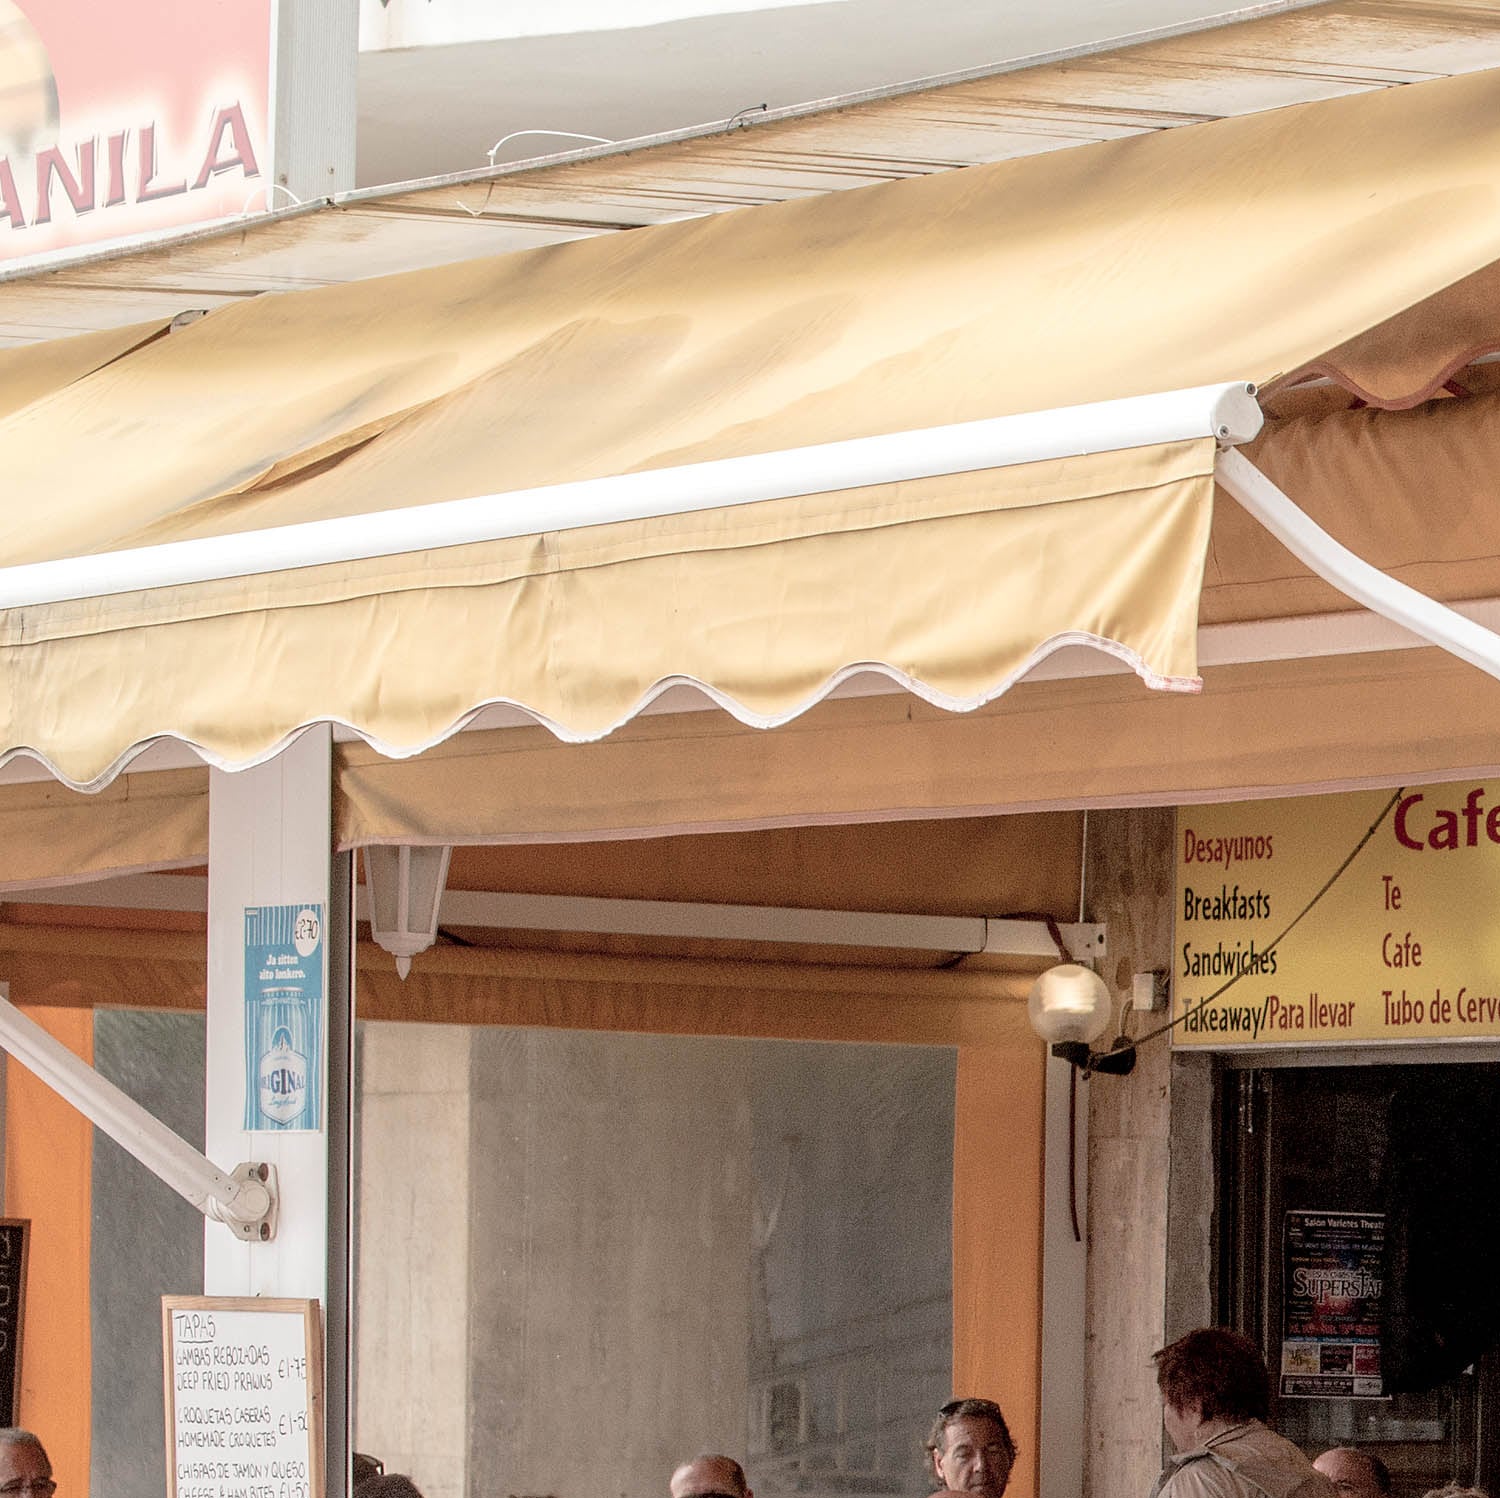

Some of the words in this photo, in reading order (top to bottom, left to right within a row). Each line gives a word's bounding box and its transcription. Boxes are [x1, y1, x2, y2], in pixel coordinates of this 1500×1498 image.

[1185, 829, 1273, 870] Desayunos
[1184, 885, 1270, 921] Breakfasts
[1382, 875, 1400, 910] Te
[1183, 941, 1277, 977] Sandwiches
[1382, 932, 1422, 968] Cafe
[1310, 993, 1355, 1028] llevar
[1382, 990, 1424, 1026] Tubo
[1430, 989, 1451, 1022] de
[175, 1314, 216, 1338] TAPAS
[202, 1370, 230, 1391] FRIED
[178, 1430, 226, 1448] HOMEMADE
[271, 1461, 306, 1479] QUESO
